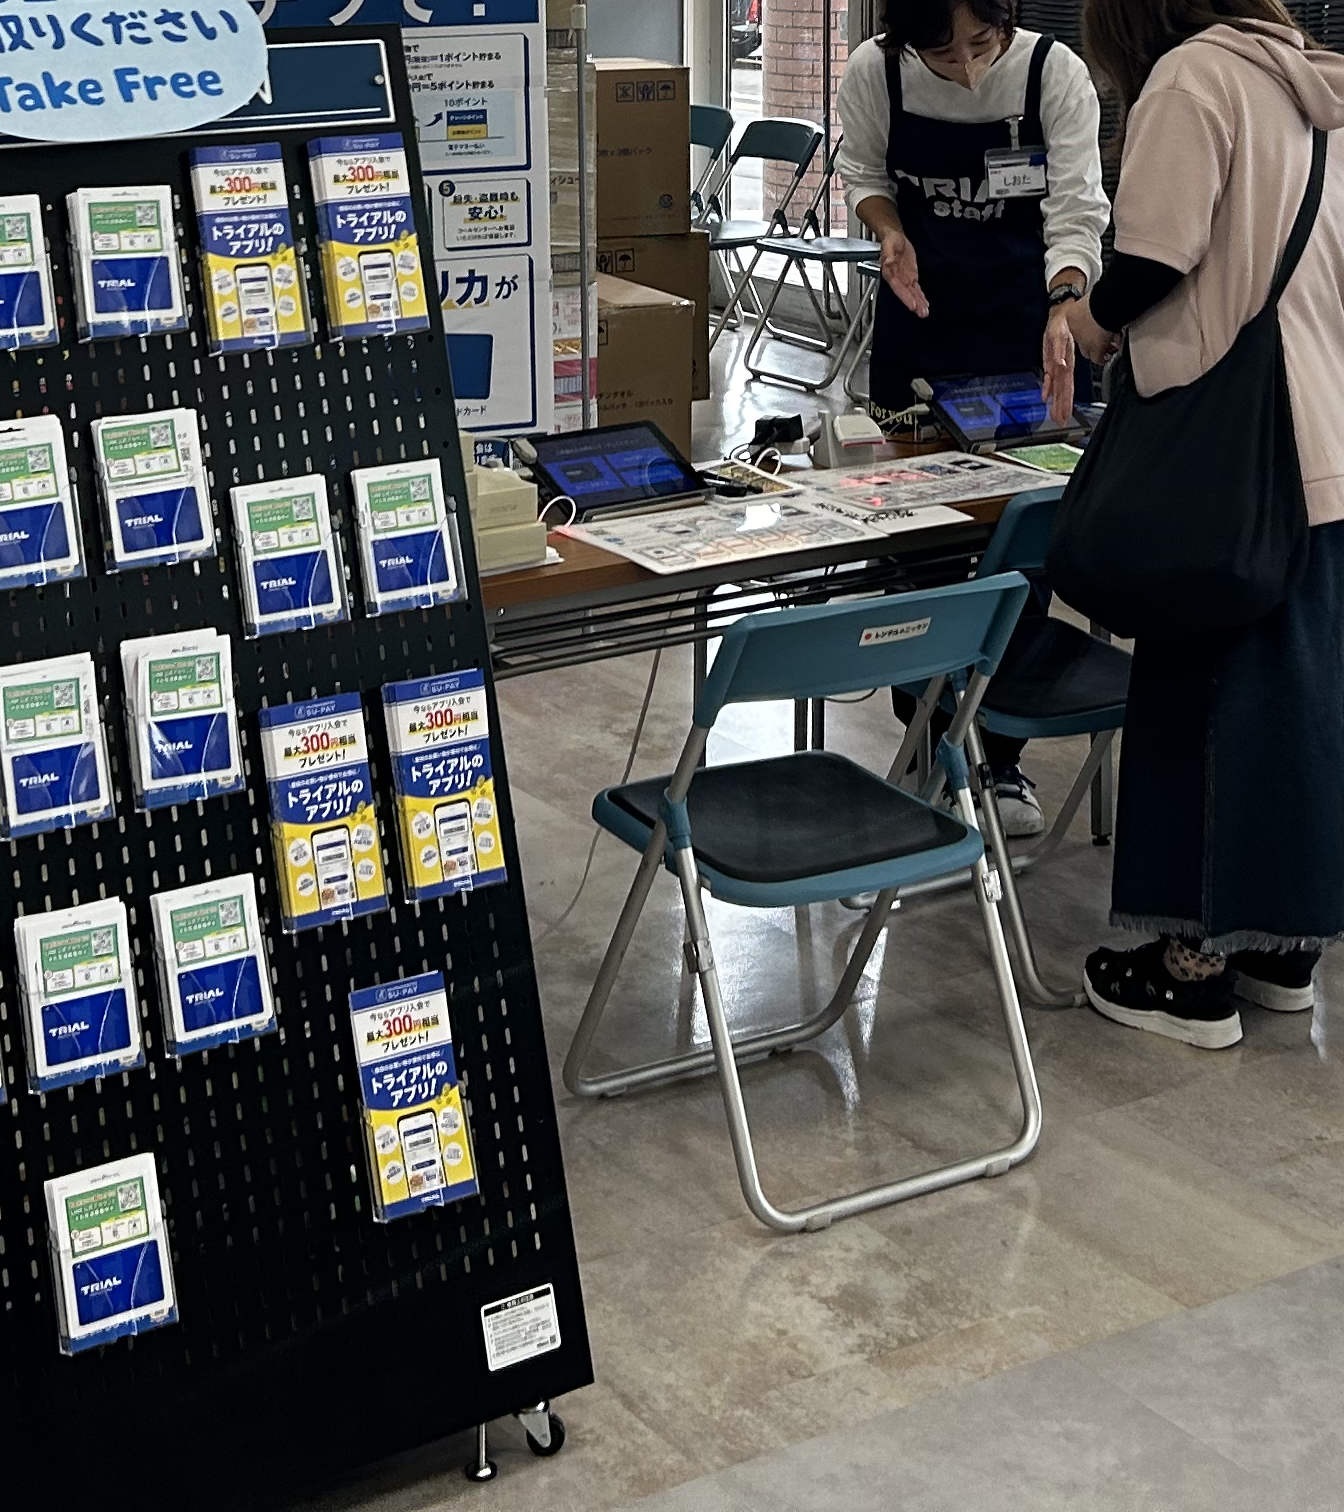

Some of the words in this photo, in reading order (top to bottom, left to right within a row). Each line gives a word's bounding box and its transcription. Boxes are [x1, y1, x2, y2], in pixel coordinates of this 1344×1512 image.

[114, 66, 225, 103] Free
[444, 98, 488, 107] 10ポイント
[346, 182, 390, 194] プレゼント!
[336, 210, 406, 228] トライアルの
[468, 206, 505, 221] 安心!
[212, 223, 285, 241] トライアルの
[352, 225, 396, 243] アプリ!
[229, 238, 273, 256] アプリ!
[98, 279, 136, 291] TRIAL
[124, 515, 164, 528] TRIAL
[379, 556, 414, 568] TRIAL
[260, 577, 297, 590] TRIAL
[423, 728, 468, 743] プレゼント!
[156, 739, 193, 753] TRIAL
[299, 749, 346, 768] プレゼント!
[411, 754, 484, 782] トライアルの
[19, 773, 59, 787] TRIAL
[429, 771, 472, 796] アプリ!
[287, 780, 364, 808] トライアルの
[306, 797, 352, 822] アプリ!
[186, 988, 224, 1005] TRIAL
[49, 1021, 90, 1038] TRIAL
[381, 1030, 429, 1053] プレゼント!
[371, 1061, 448, 1093] トライアルの
[390, 1079, 437, 1107] アプリ!
[80, 1276, 122, 1296] TRIAL
